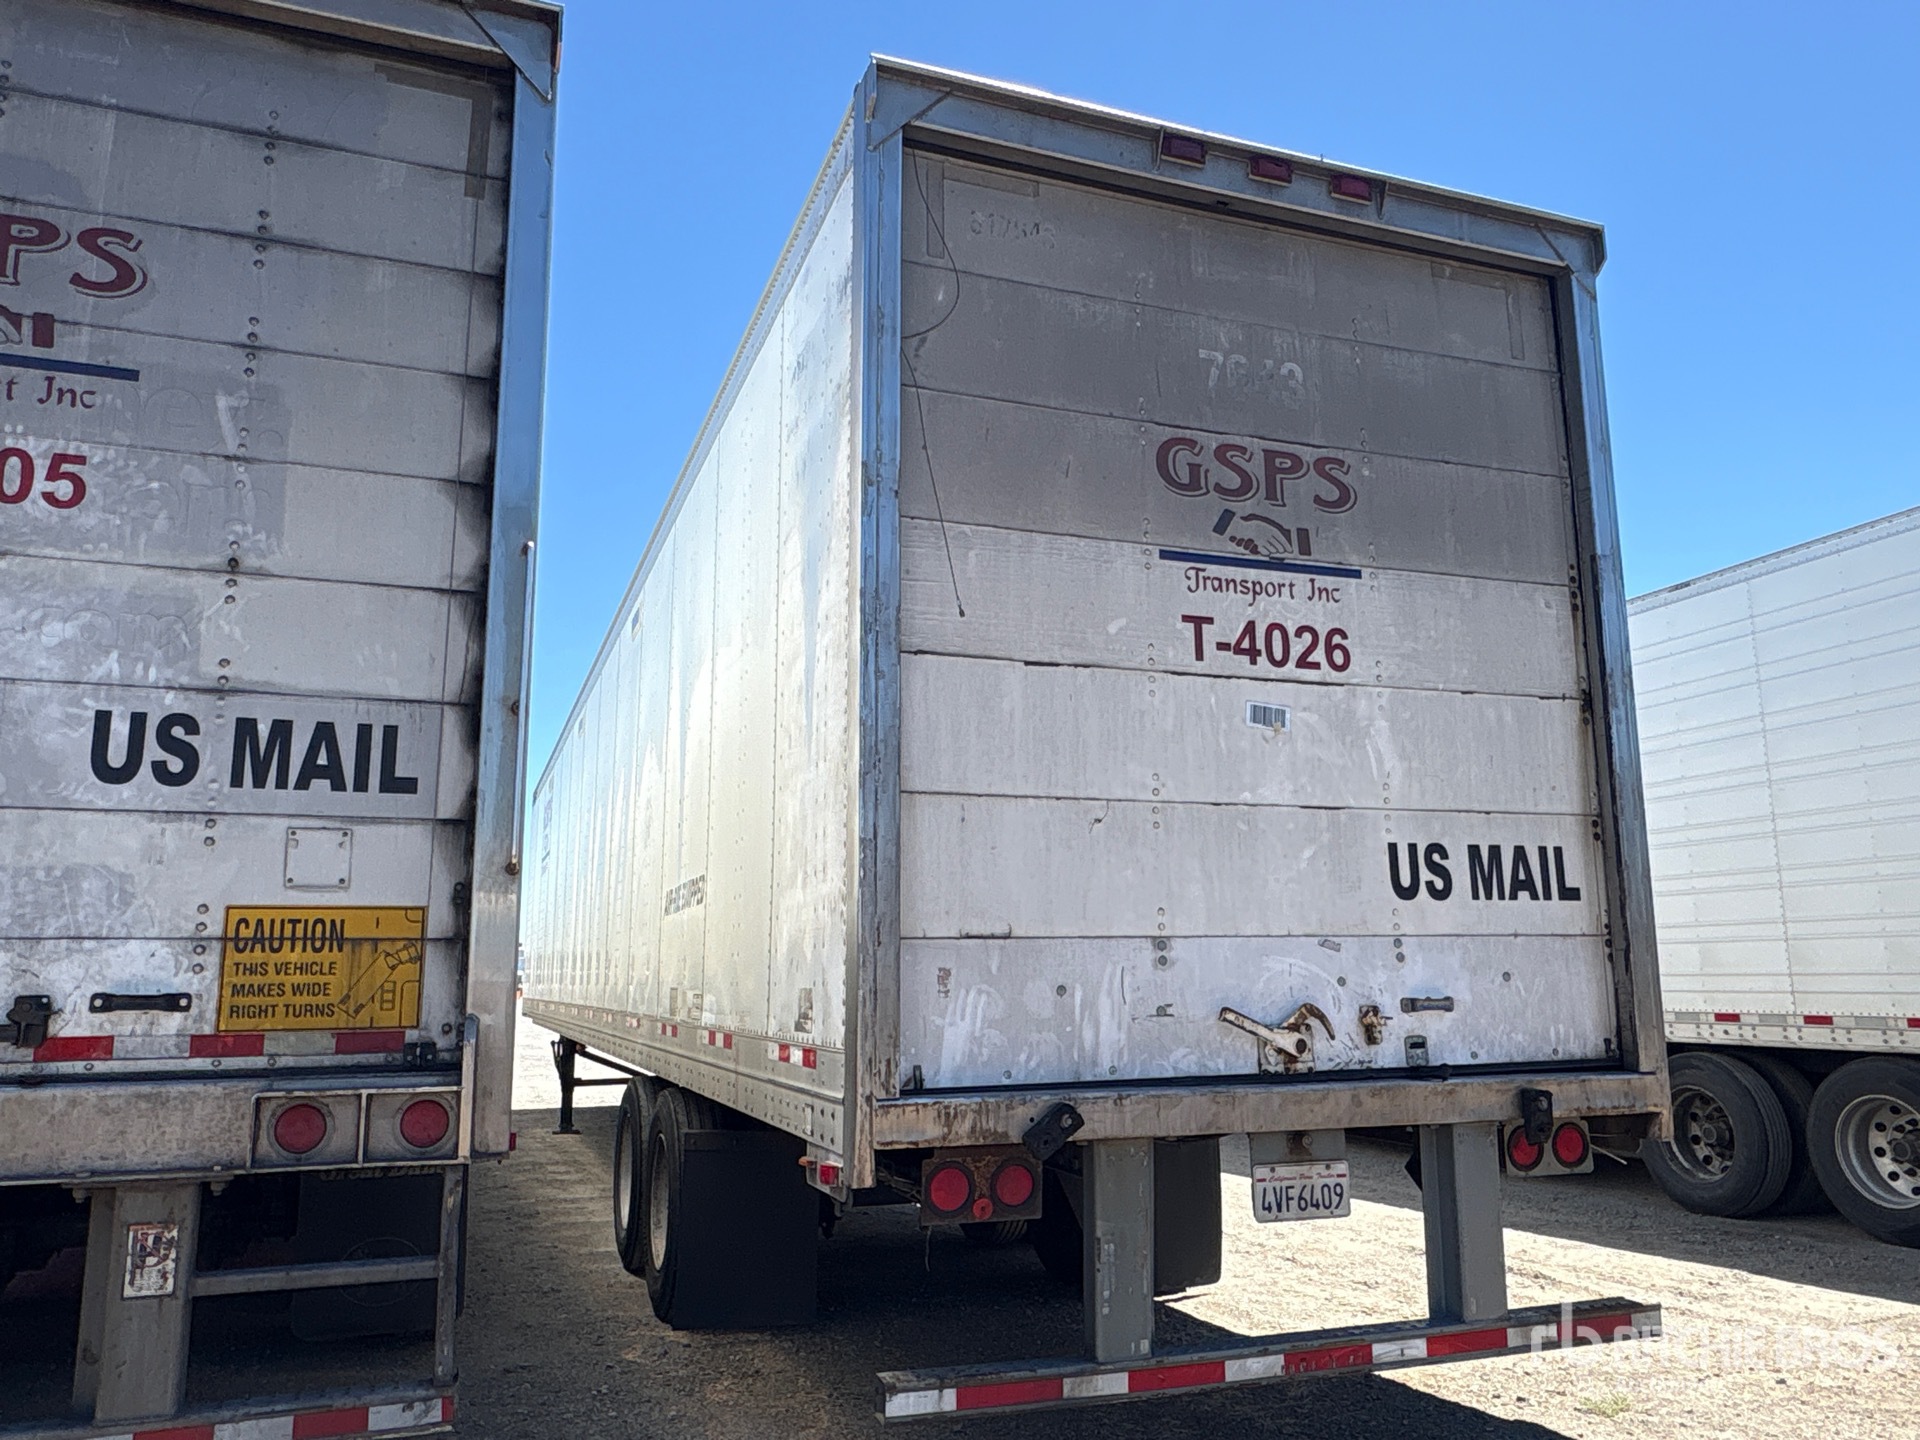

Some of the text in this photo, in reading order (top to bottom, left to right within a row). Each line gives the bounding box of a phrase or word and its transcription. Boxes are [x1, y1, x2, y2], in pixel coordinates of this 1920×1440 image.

[0, 447, 87, 509] 05
[1156, 437, 1357, 514] GSPS
[1184, 566, 1296, 607] Transport
[1181, 614, 1351, 672] T-4026
[90, 709, 418, 794] US MAIL
[1387, 842, 1581, 901] US MAIL
[233, 917, 345, 954] CAUTION
[233, 961, 337, 977] THIS VEHICLE
[231, 982, 331, 998] MAKES WIDE
[229, 1003, 335, 1019] RIGHT TURNS
[1262, 1183, 1344, 1214] 4VF6409
